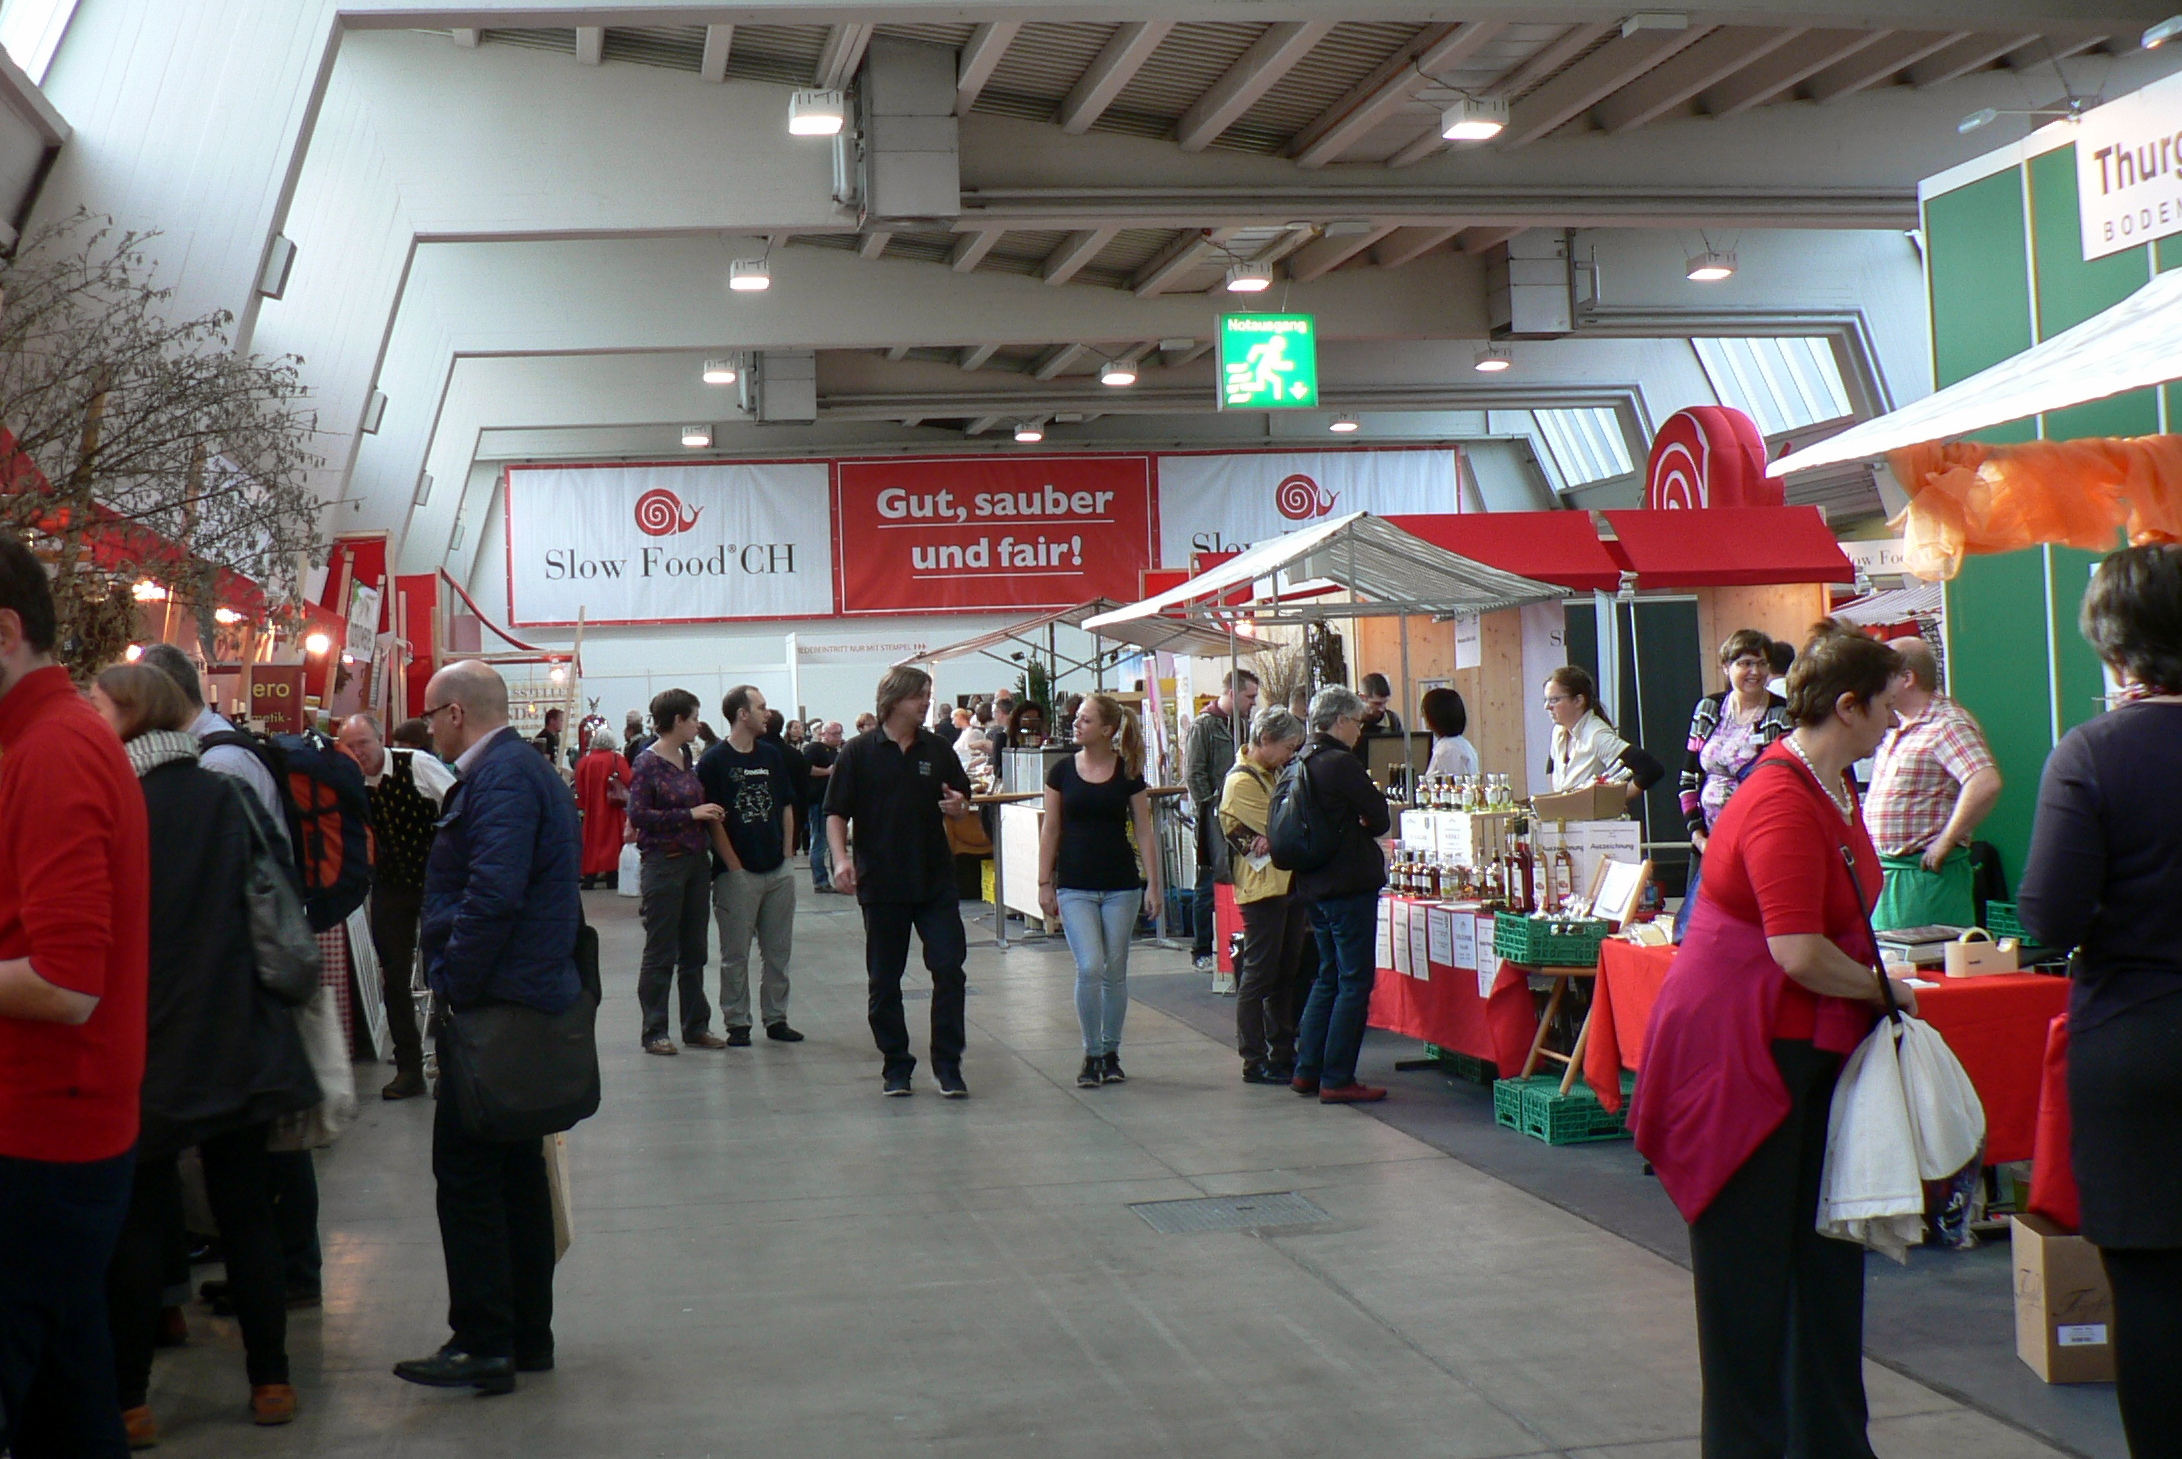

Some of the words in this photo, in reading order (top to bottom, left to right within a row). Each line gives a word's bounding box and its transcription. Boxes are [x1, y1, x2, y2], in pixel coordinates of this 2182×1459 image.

[1227, 318, 1307, 334] Notausgang
[876, 487, 968, 523] Gut,
[974, 484, 1114, 516] sauber
[545, 548, 628, 580] Slow
[912, 537, 989, 569] und
[997, 534, 1083, 568] fair!
